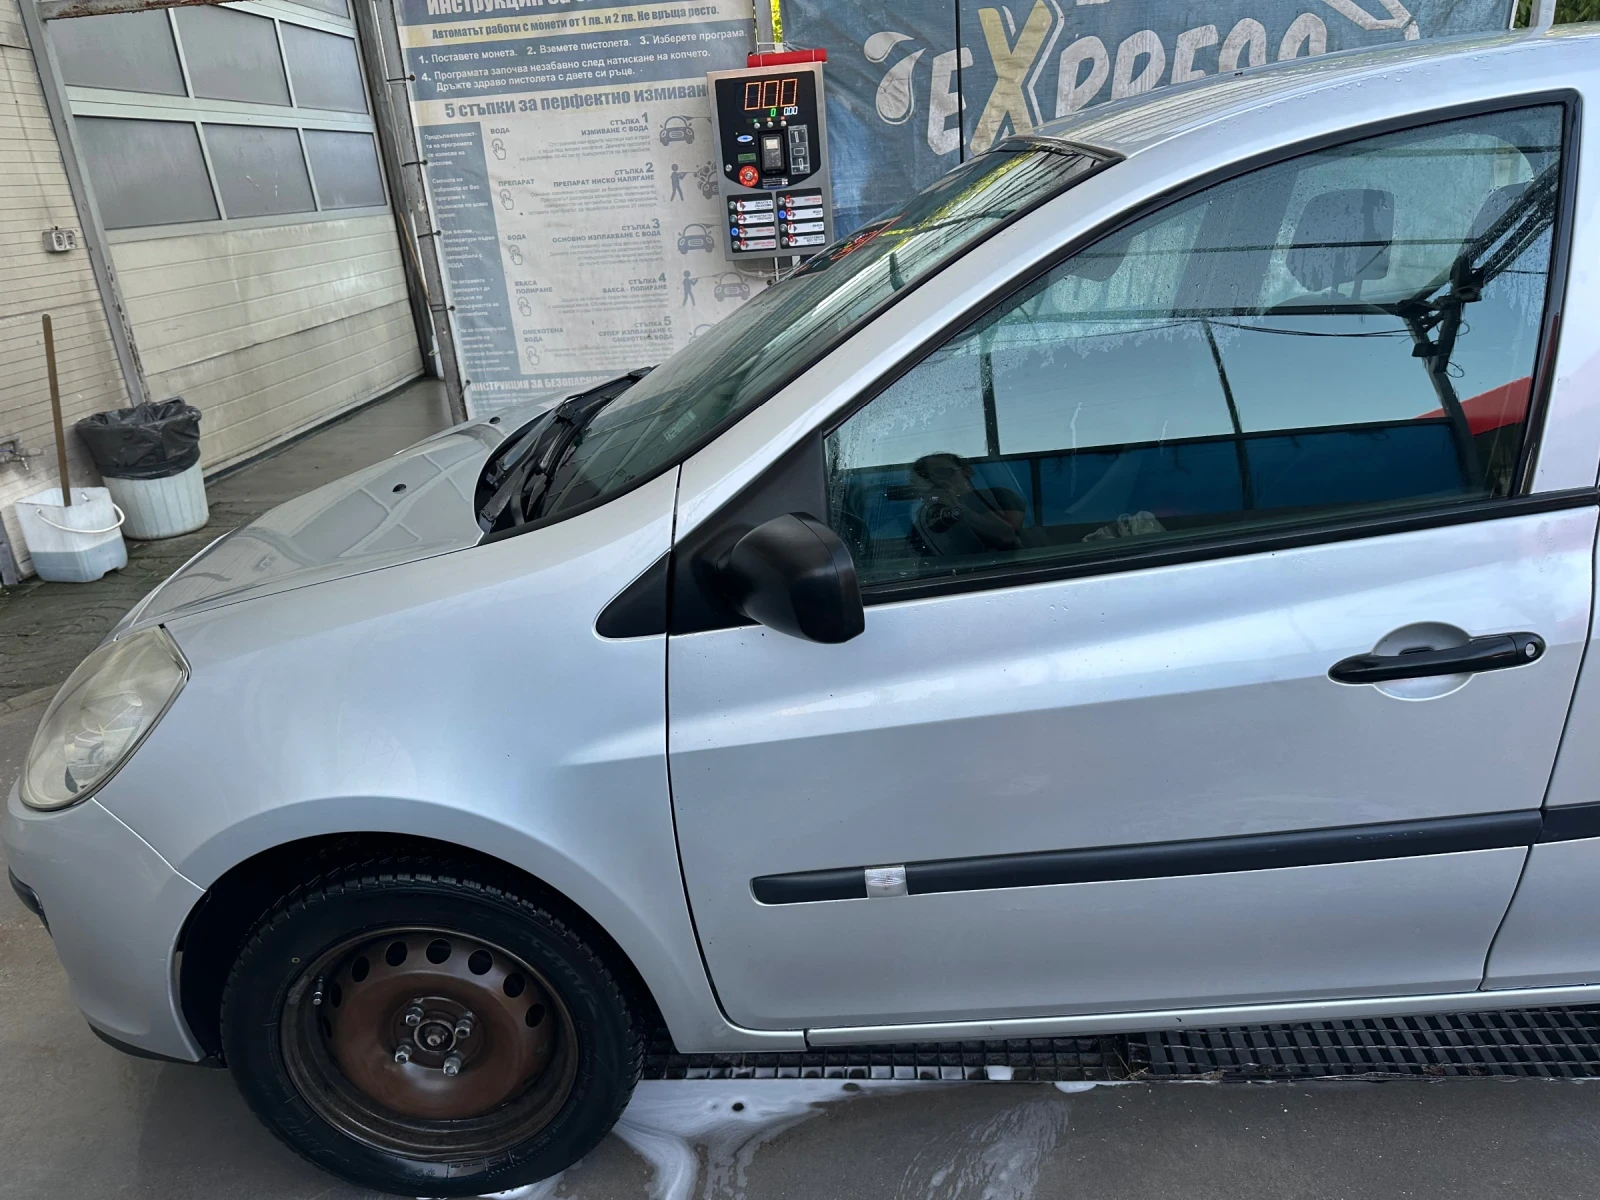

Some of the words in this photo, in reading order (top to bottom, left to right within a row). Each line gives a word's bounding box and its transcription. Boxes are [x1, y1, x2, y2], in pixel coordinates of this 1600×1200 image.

[432, 26, 483, 39] Автоматът
[486, 23, 521, 36] работи
[523, 24, 529, 32] с
[531, 19, 567, 31] монети
[569, 18, 580, 28] от
[582, 16, 587, 26] 1
[588, 16, 603, 25] лв.
[605, 16, 611, 24] и
[613, 14, 620, 24] 2
[622, 12, 636, 23] лв.
[638, 10, 650, 21] Не
[652, 8, 686, 21] връща
[688, 6, 720, 18] ресто.
[640, 36, 650, 45] 3.
[653, 32, 697, 45] Изберете
[699, 30, 747, 41] програма.
[527, 46, 537, 56] 2.
[540, 43, 578, 54] Вземете
[581, 38, 632, 50] пистолета.
[418, 56, 429, 64] 1.
[431, 51, 479, 63] Поставете
[482, 50, 518, 60] монета.
[422, 73, 432, 82] 4.
[434, 69, 489, 81] Програмата
[491, 66, 528, 76] започва
[530, 60, 580, 73] незабавно
[582, 59, 605, 68] след
[606, 54, 655, 65] натискане
[657, 53, 668, 61] на
[670, 50, 711, 60] копчето.
[436, 82, 472, 93] Дръжте
[474, 78, 507, 89] здраво
[509, 74, 556, 85] пистолета
[566, 71, 593, 82] двете
[596, 70, 607, 78] си
[609, 68, 635, 79] ръце.
[445, 103, 456, 118] 5
[458, 100, 516, 117] стъпки
[519, 98, 538, 112] за
[540, 90, 631, 111] перфектно
[634, 84, 709, 103] измиван
[610, 118, 640, 126] СТЪПКА
[642, 112, 649, 123] 1
[581, 127, 621, 136] ИЗМИВАНЕ
[614, 168, 644, 176] СТЪПКА
[645, 162, 654, 173] 2
[498, 178, 535, 187] ПРЕПАРАТ
[553, 180, 590, 188] ПРЕПАРАТ
[592, 177, 616, 185] НИСКО
[617, 174, 655, 183] НАЛЯГАНЕ
[652, 218, 660, 229] 3
[588, 233, 634, 241] ИЗПЛАКВАНЕ
[658, 272, 667, 283] 4
[630, 284, 668, 292] ПОЛИРАНЕ
[664, 316, 672, 326] 5
[622, 327, 667, 336] ИЗПЛАКВАНЕ
[472, 380, 530, 392] ИНСТРУКЦИЯ
[531, 379, 544, 389] ЗА
[545, 376, 610, 388] БЕЗОПАСН
